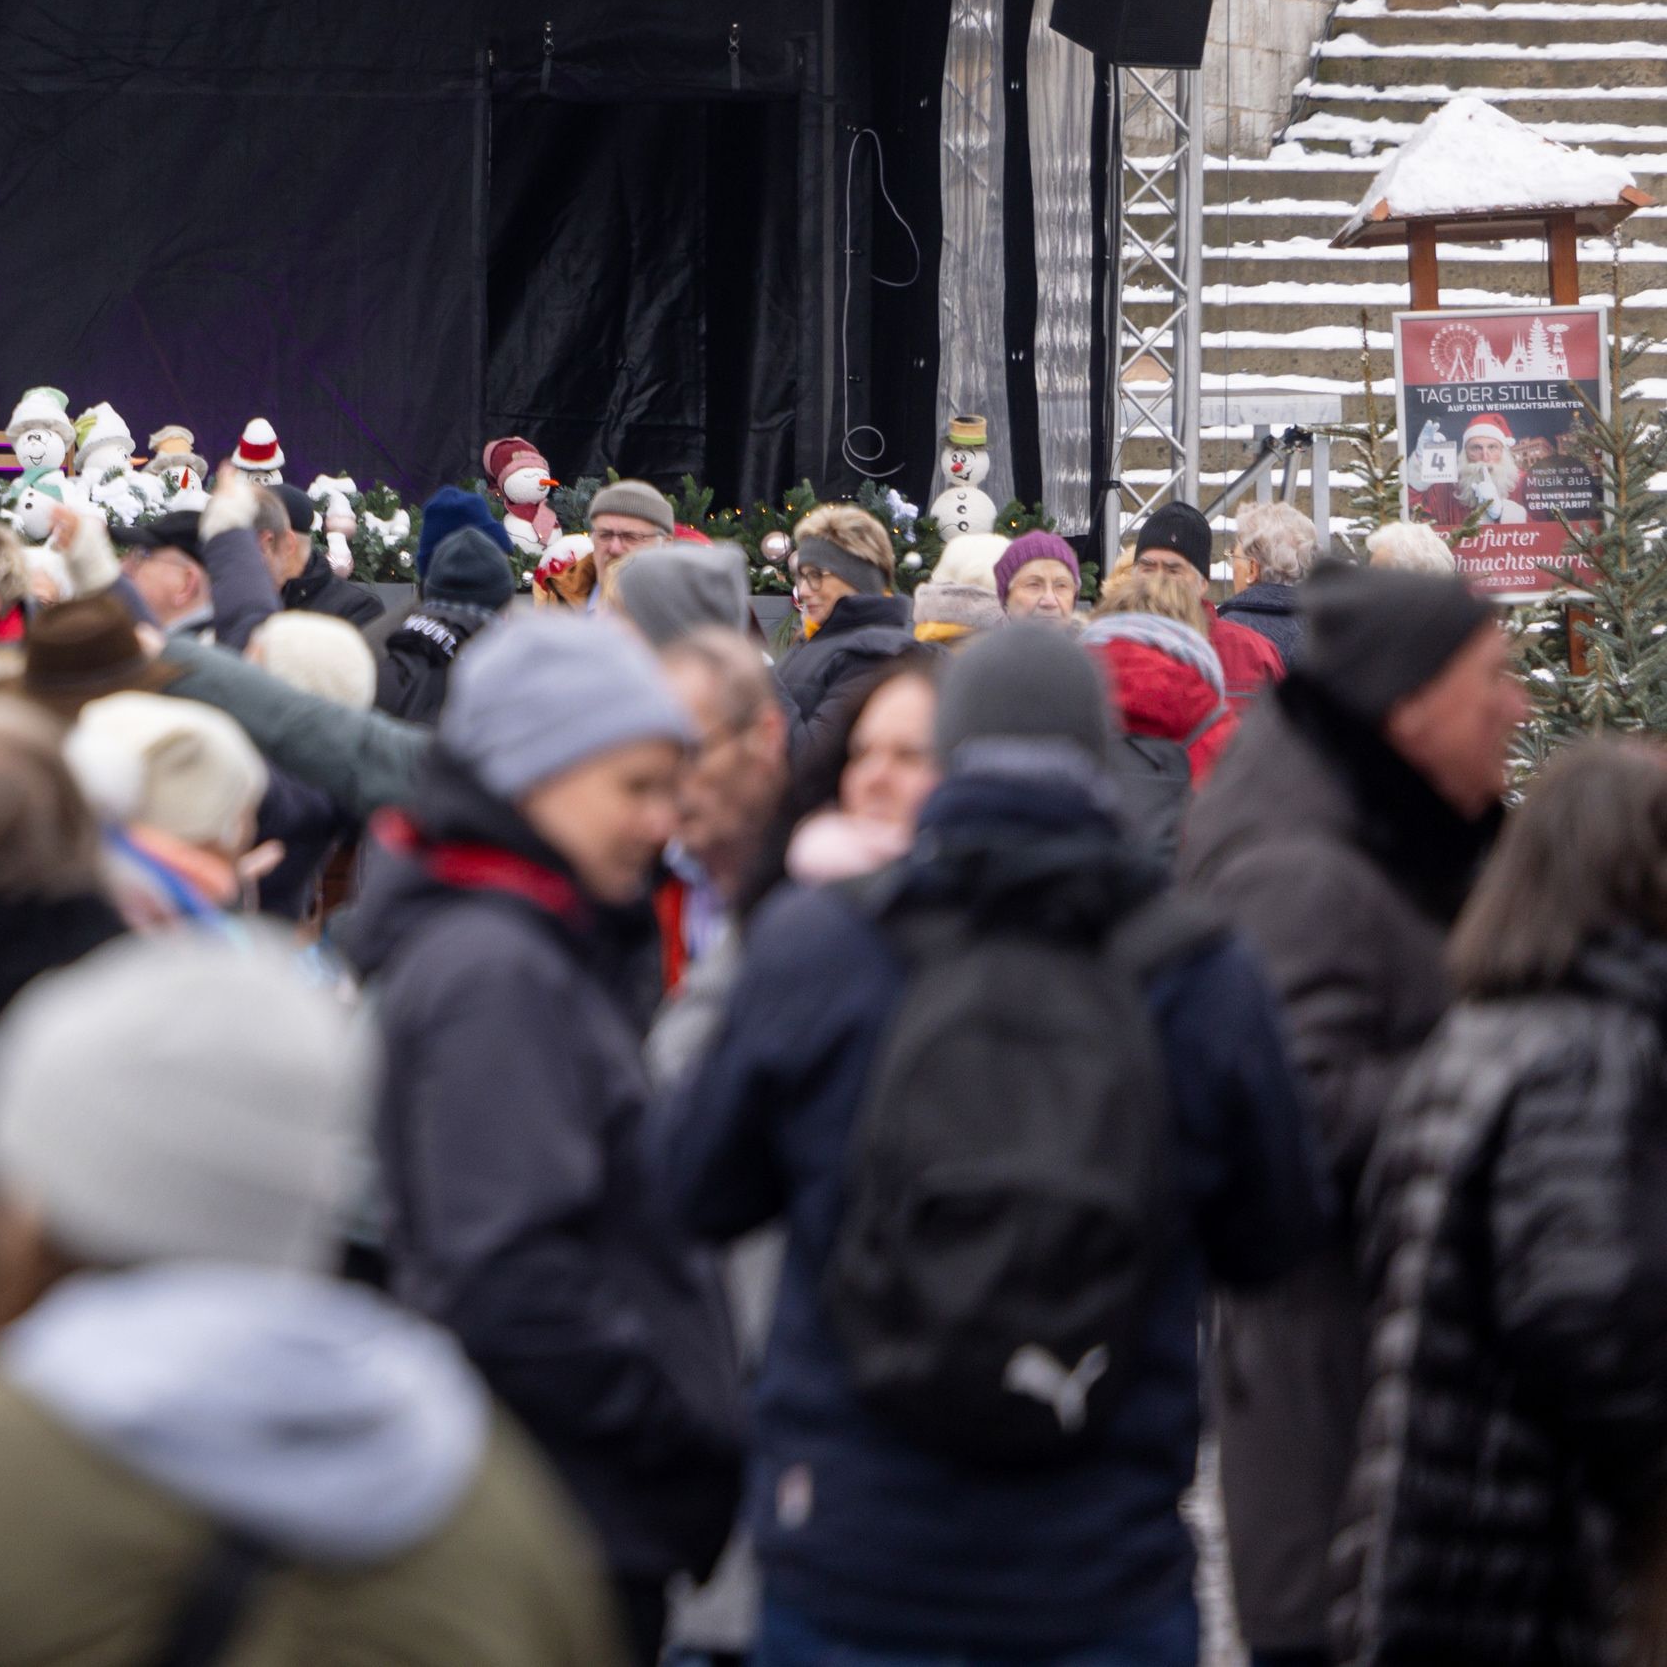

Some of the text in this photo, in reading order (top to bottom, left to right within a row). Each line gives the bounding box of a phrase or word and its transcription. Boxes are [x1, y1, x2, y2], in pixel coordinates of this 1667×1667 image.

[1416, 384, 1559, 405] TAG DER STILLE
[1447, 400, 1584, 412] AUF DEN WEIHNACHTSMÄRKTEN
[1431, 452, 1446, 473] 4
[1532, 467, 1557, 475] Heute
[1571, 466, 1584, 474] die
[1526, 475, 1591, 488] Musik aus
[1525, 491, 1593, 501] FÜR EINEN FAIREN
[1528, 500, 1591, 510] GEMA-TARIF!
[1459, 529, 1540, 552] Erfurter
[1486, 575, 1536, 587] 22.12.2023
[402, 614, 457, 658] MOUNT
